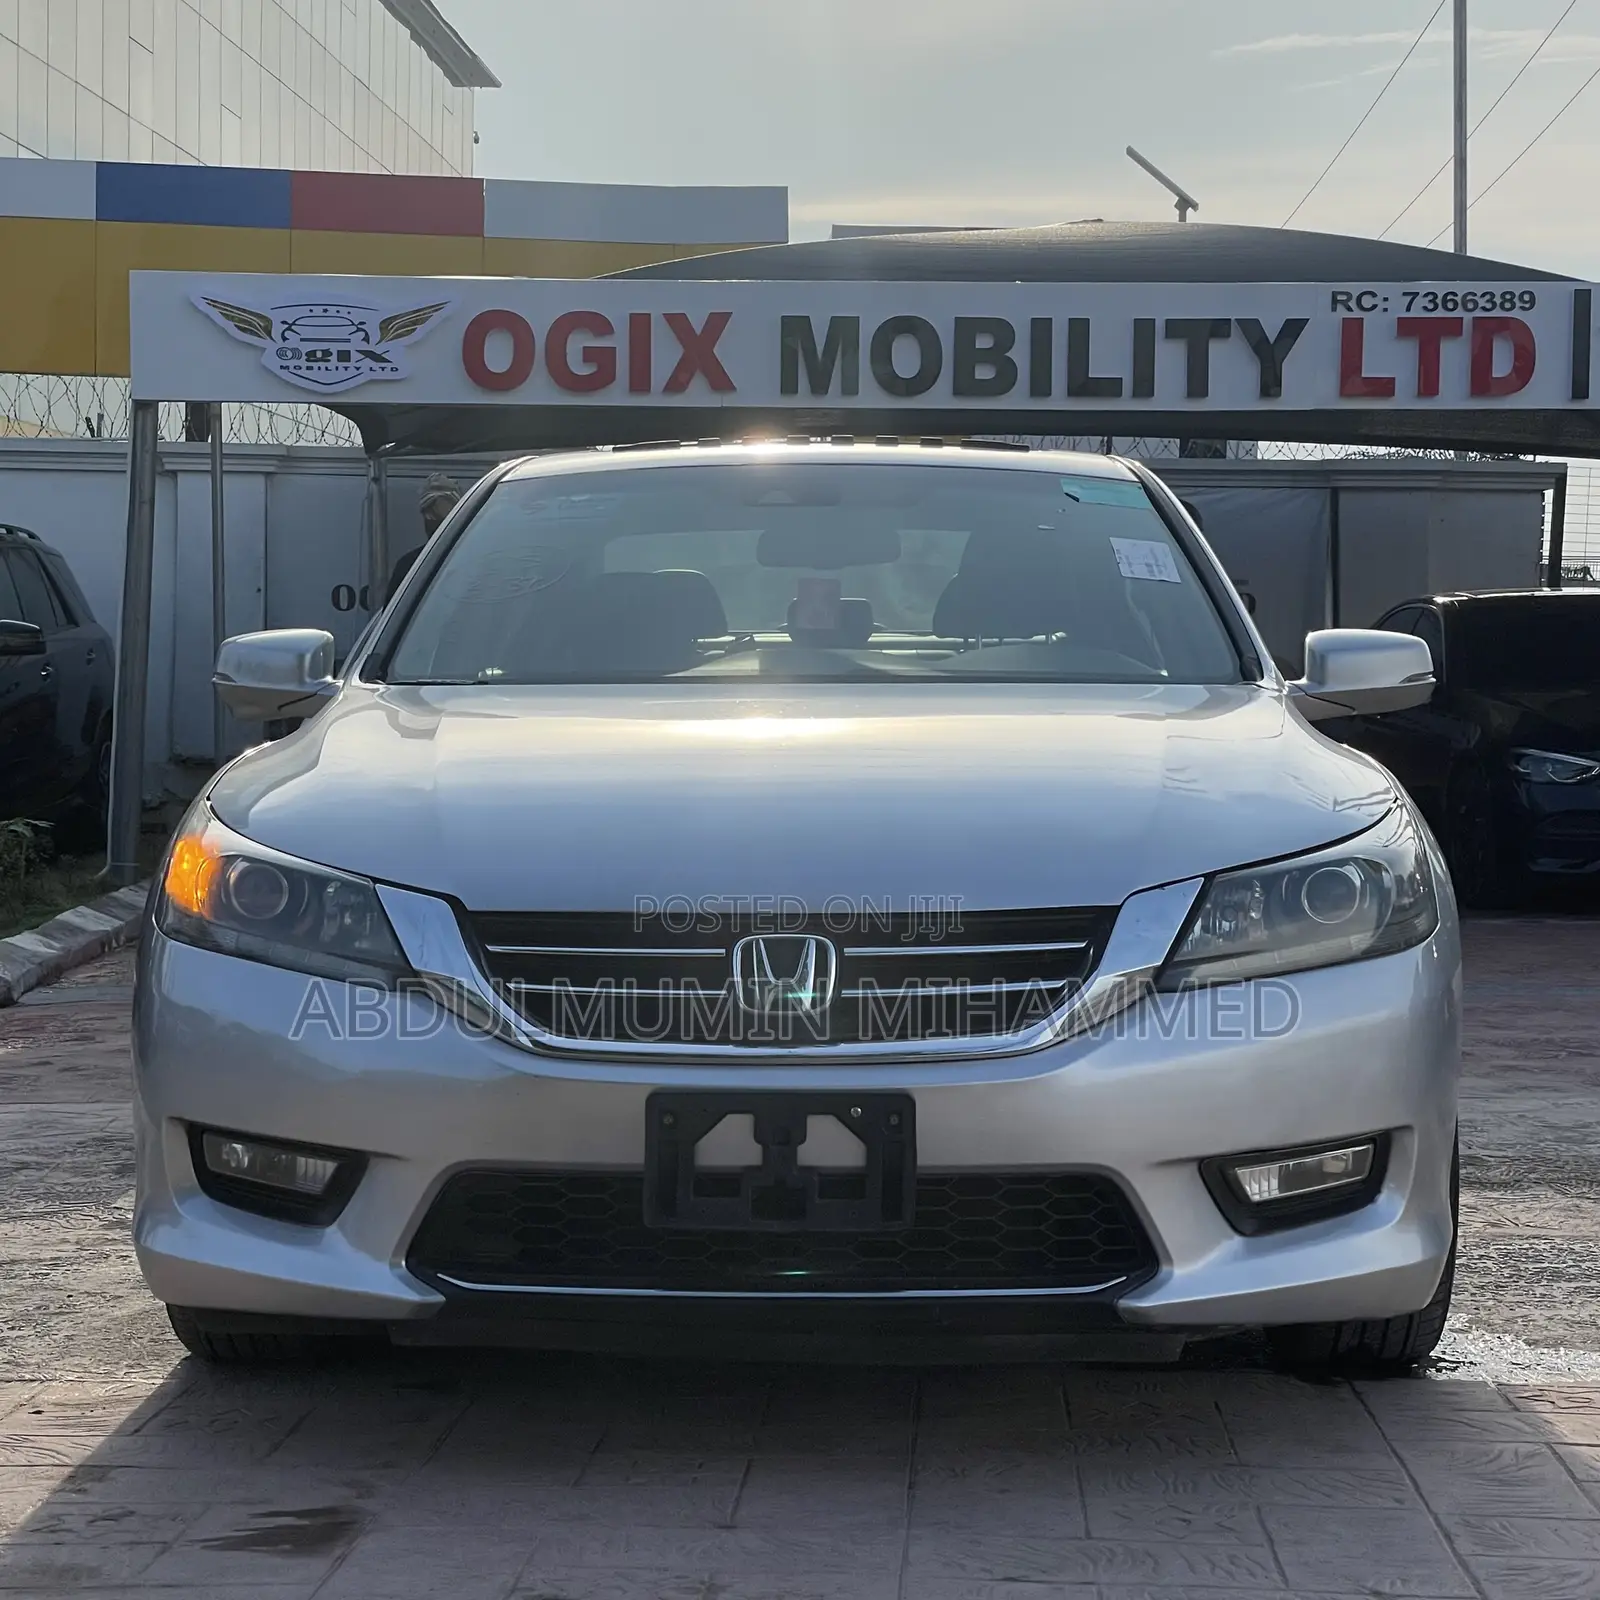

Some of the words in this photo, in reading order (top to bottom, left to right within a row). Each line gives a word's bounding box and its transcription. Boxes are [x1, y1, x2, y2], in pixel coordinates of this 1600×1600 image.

[1330, 291, 1389, 312] RC:
[1401, 291, 1537, 312] 7366389
[461, 308, 737, 394] OGIX
[780, 313, 1310, 399] MOBILITY
[1338, 316, 1536, 397] LTD
